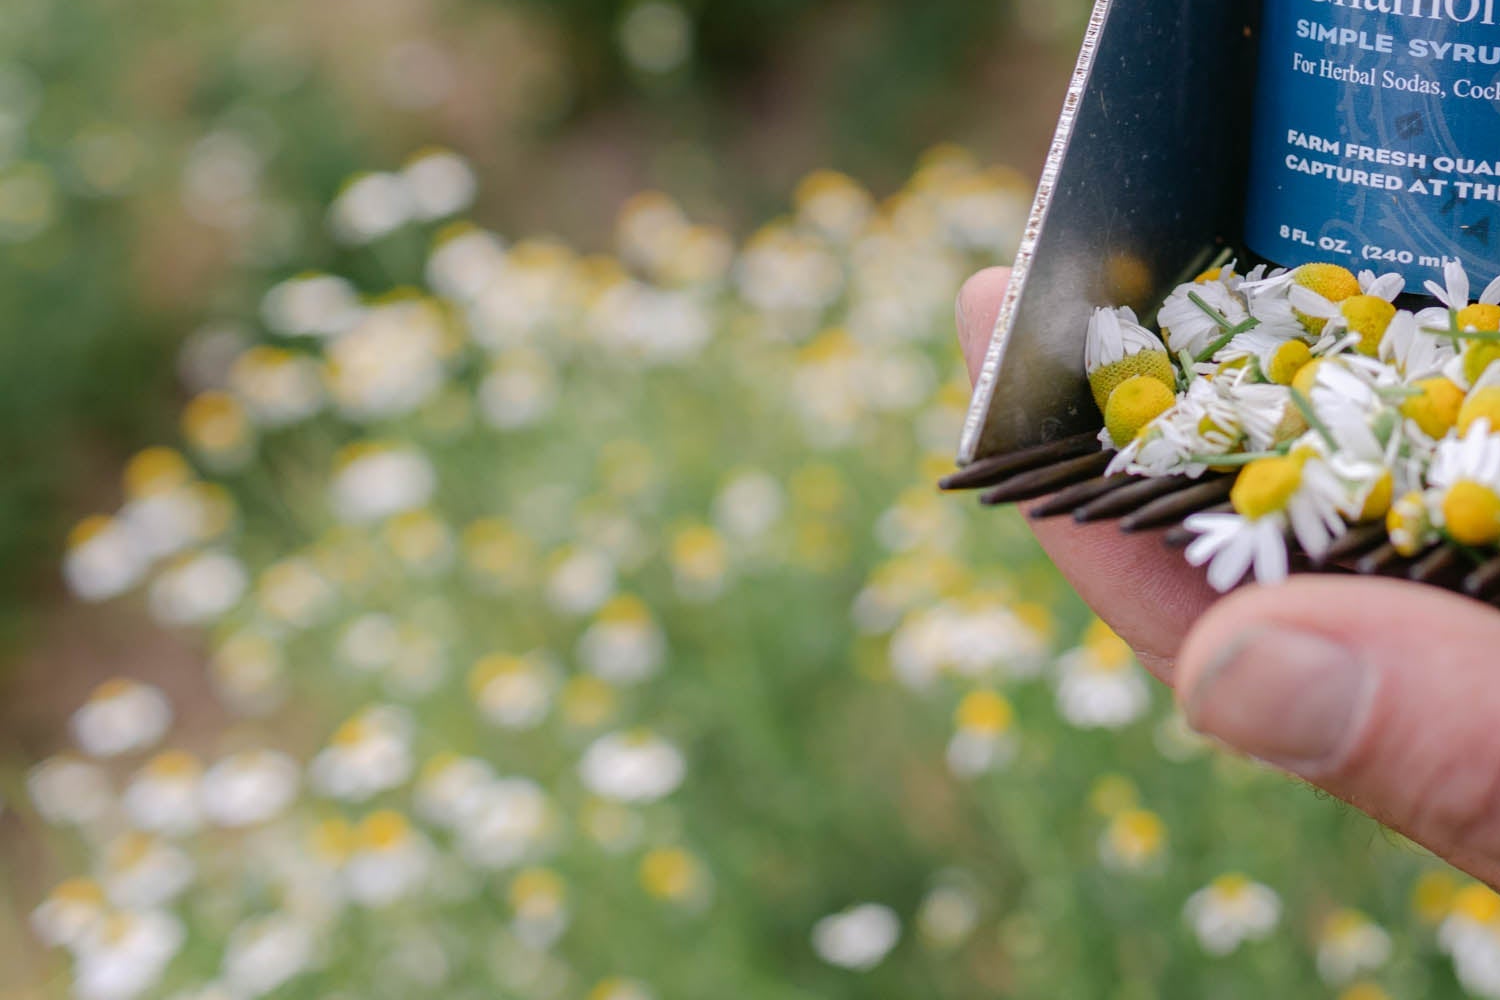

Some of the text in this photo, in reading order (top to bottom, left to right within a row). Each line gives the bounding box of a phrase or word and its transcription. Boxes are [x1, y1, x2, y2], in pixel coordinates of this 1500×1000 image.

[1296, 19, 1394, 53] SIMPLE
[1293, 52, 1317, 75] For
[1319, 58, 1375, 87] Herbal
[1381, 70, 1446, 98] Sodas,
[1287, 128, 1340, 156] FARM
[1344, 143, 1427, 169] FRESH
[1285, 154, 1403, 191] CAPTURED
[1407, 179, 1448, 196] AT
[1279, 224, 1290, 239] 8
[1292, 228, 1315, 246] FL.
[1319, 236, 1352, 255] OZ.
[1361, 244, 1414, 264] (240
